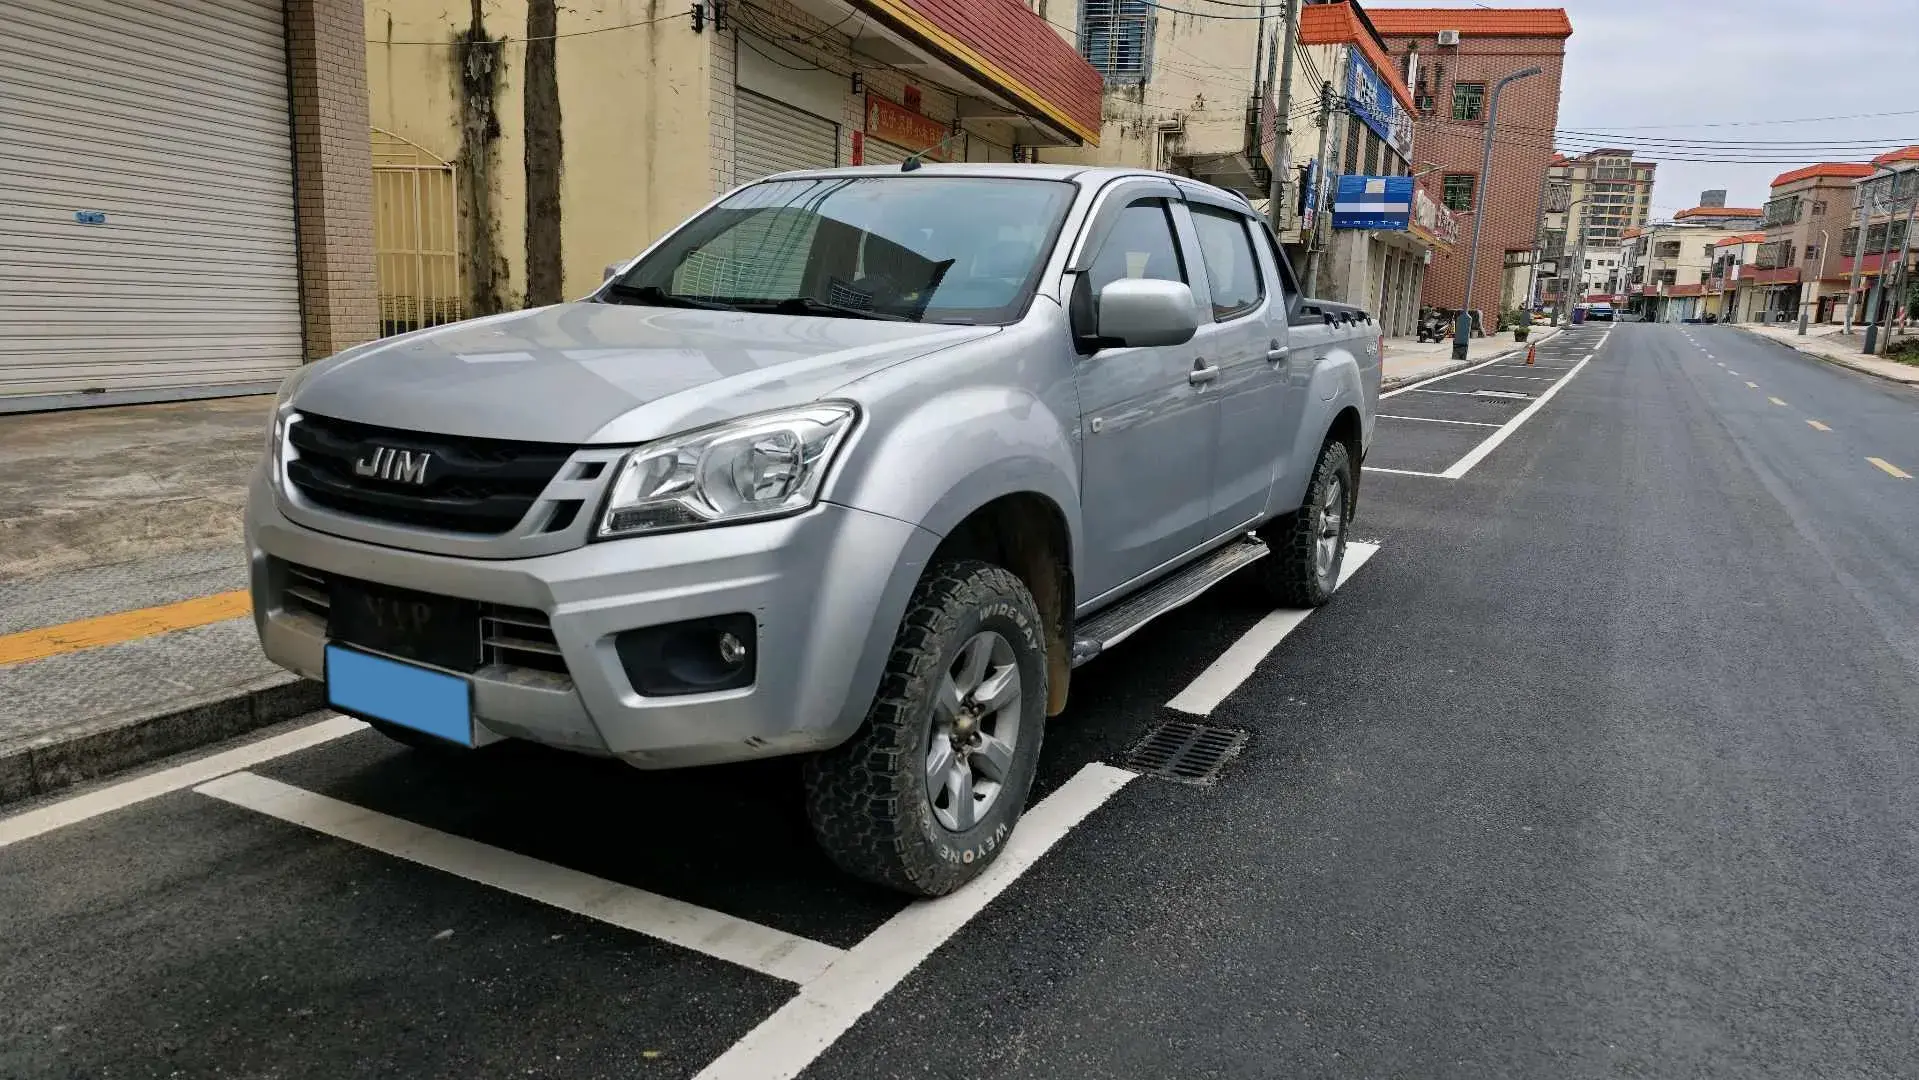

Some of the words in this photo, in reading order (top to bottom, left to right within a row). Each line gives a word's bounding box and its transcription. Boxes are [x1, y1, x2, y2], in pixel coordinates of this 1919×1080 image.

[355, 447, 431, 484] JIM
[979, 602, 1039, 650] WIDEWAY
[939, 822, 1008, 865] WEYONE
